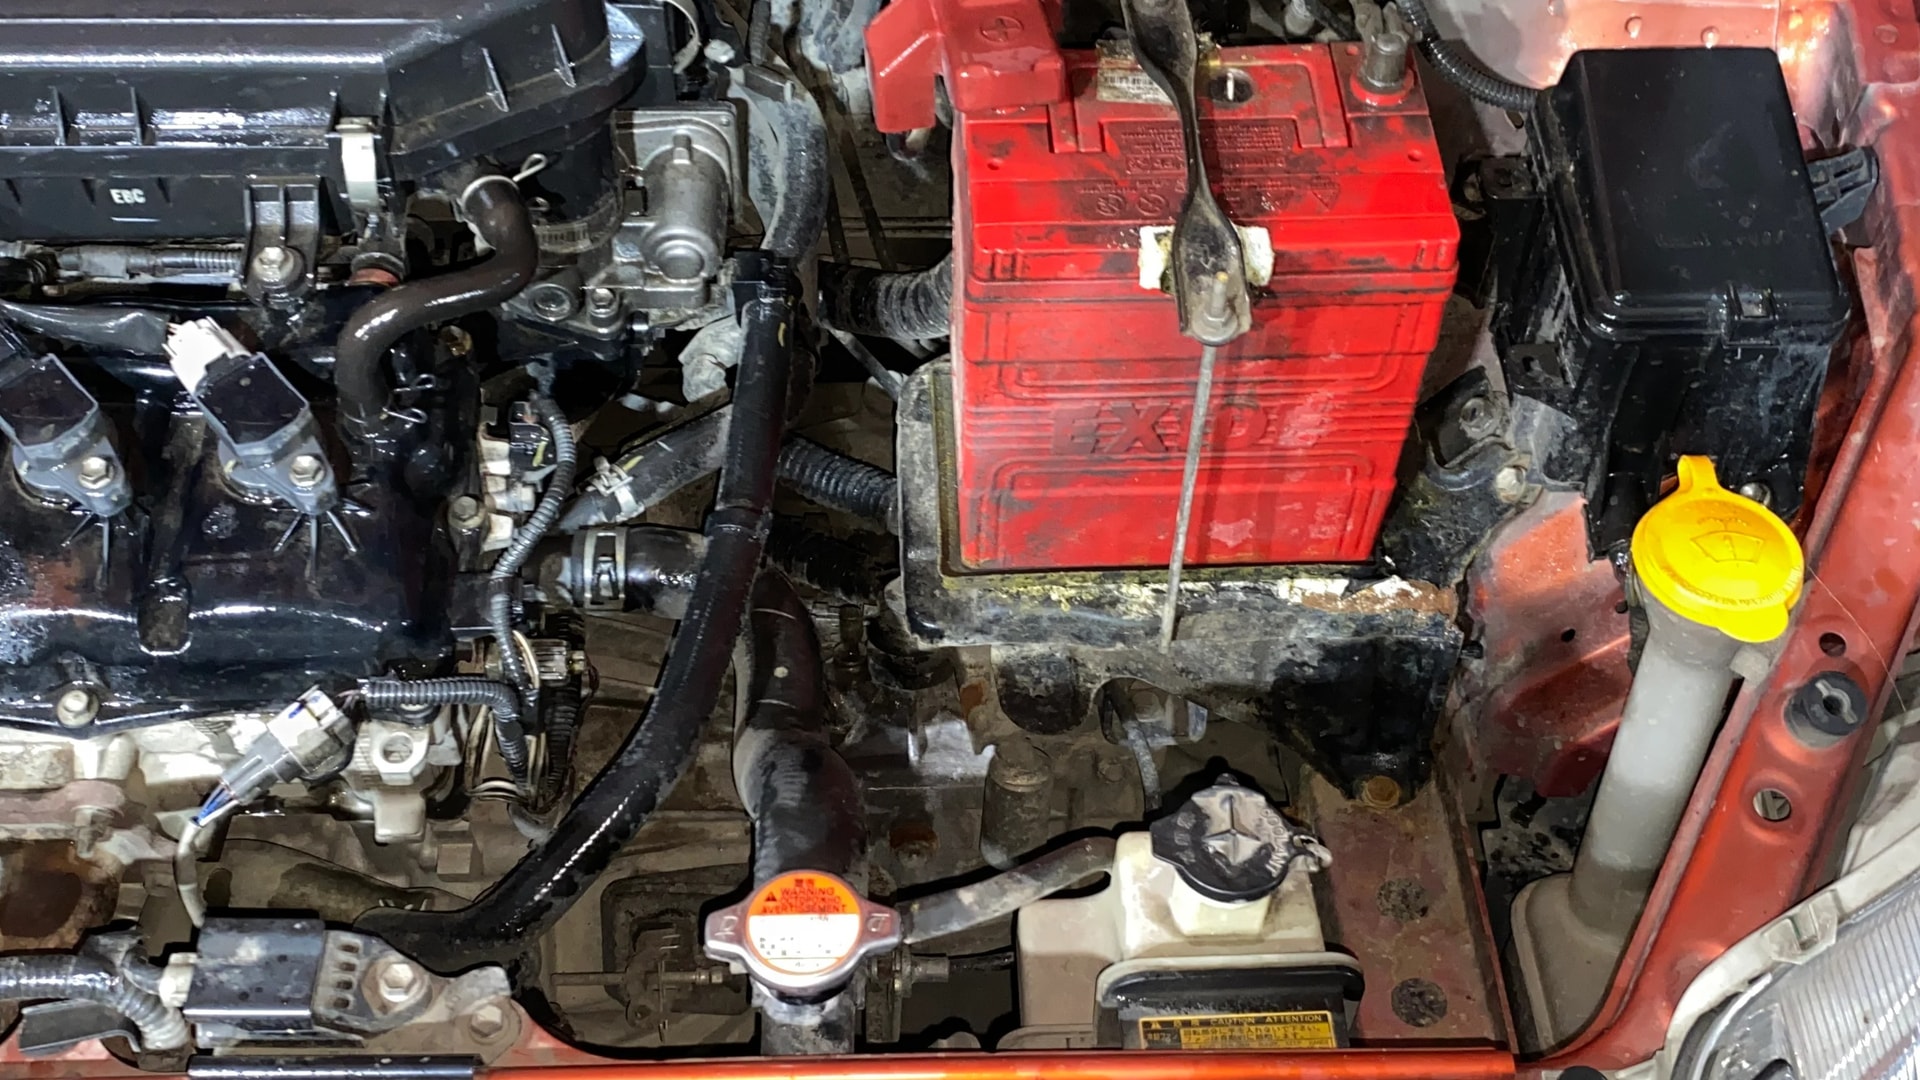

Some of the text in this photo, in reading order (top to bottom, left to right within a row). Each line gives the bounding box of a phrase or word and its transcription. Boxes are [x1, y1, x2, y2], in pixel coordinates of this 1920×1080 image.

[1260, 808, 1289, 878] COOLANT
[780, 887, 835, 896] WARNING
[1210, 1017, 1255, 1025] CAUTION
[1264, 1014, 1322, 1023] ATTENTION
